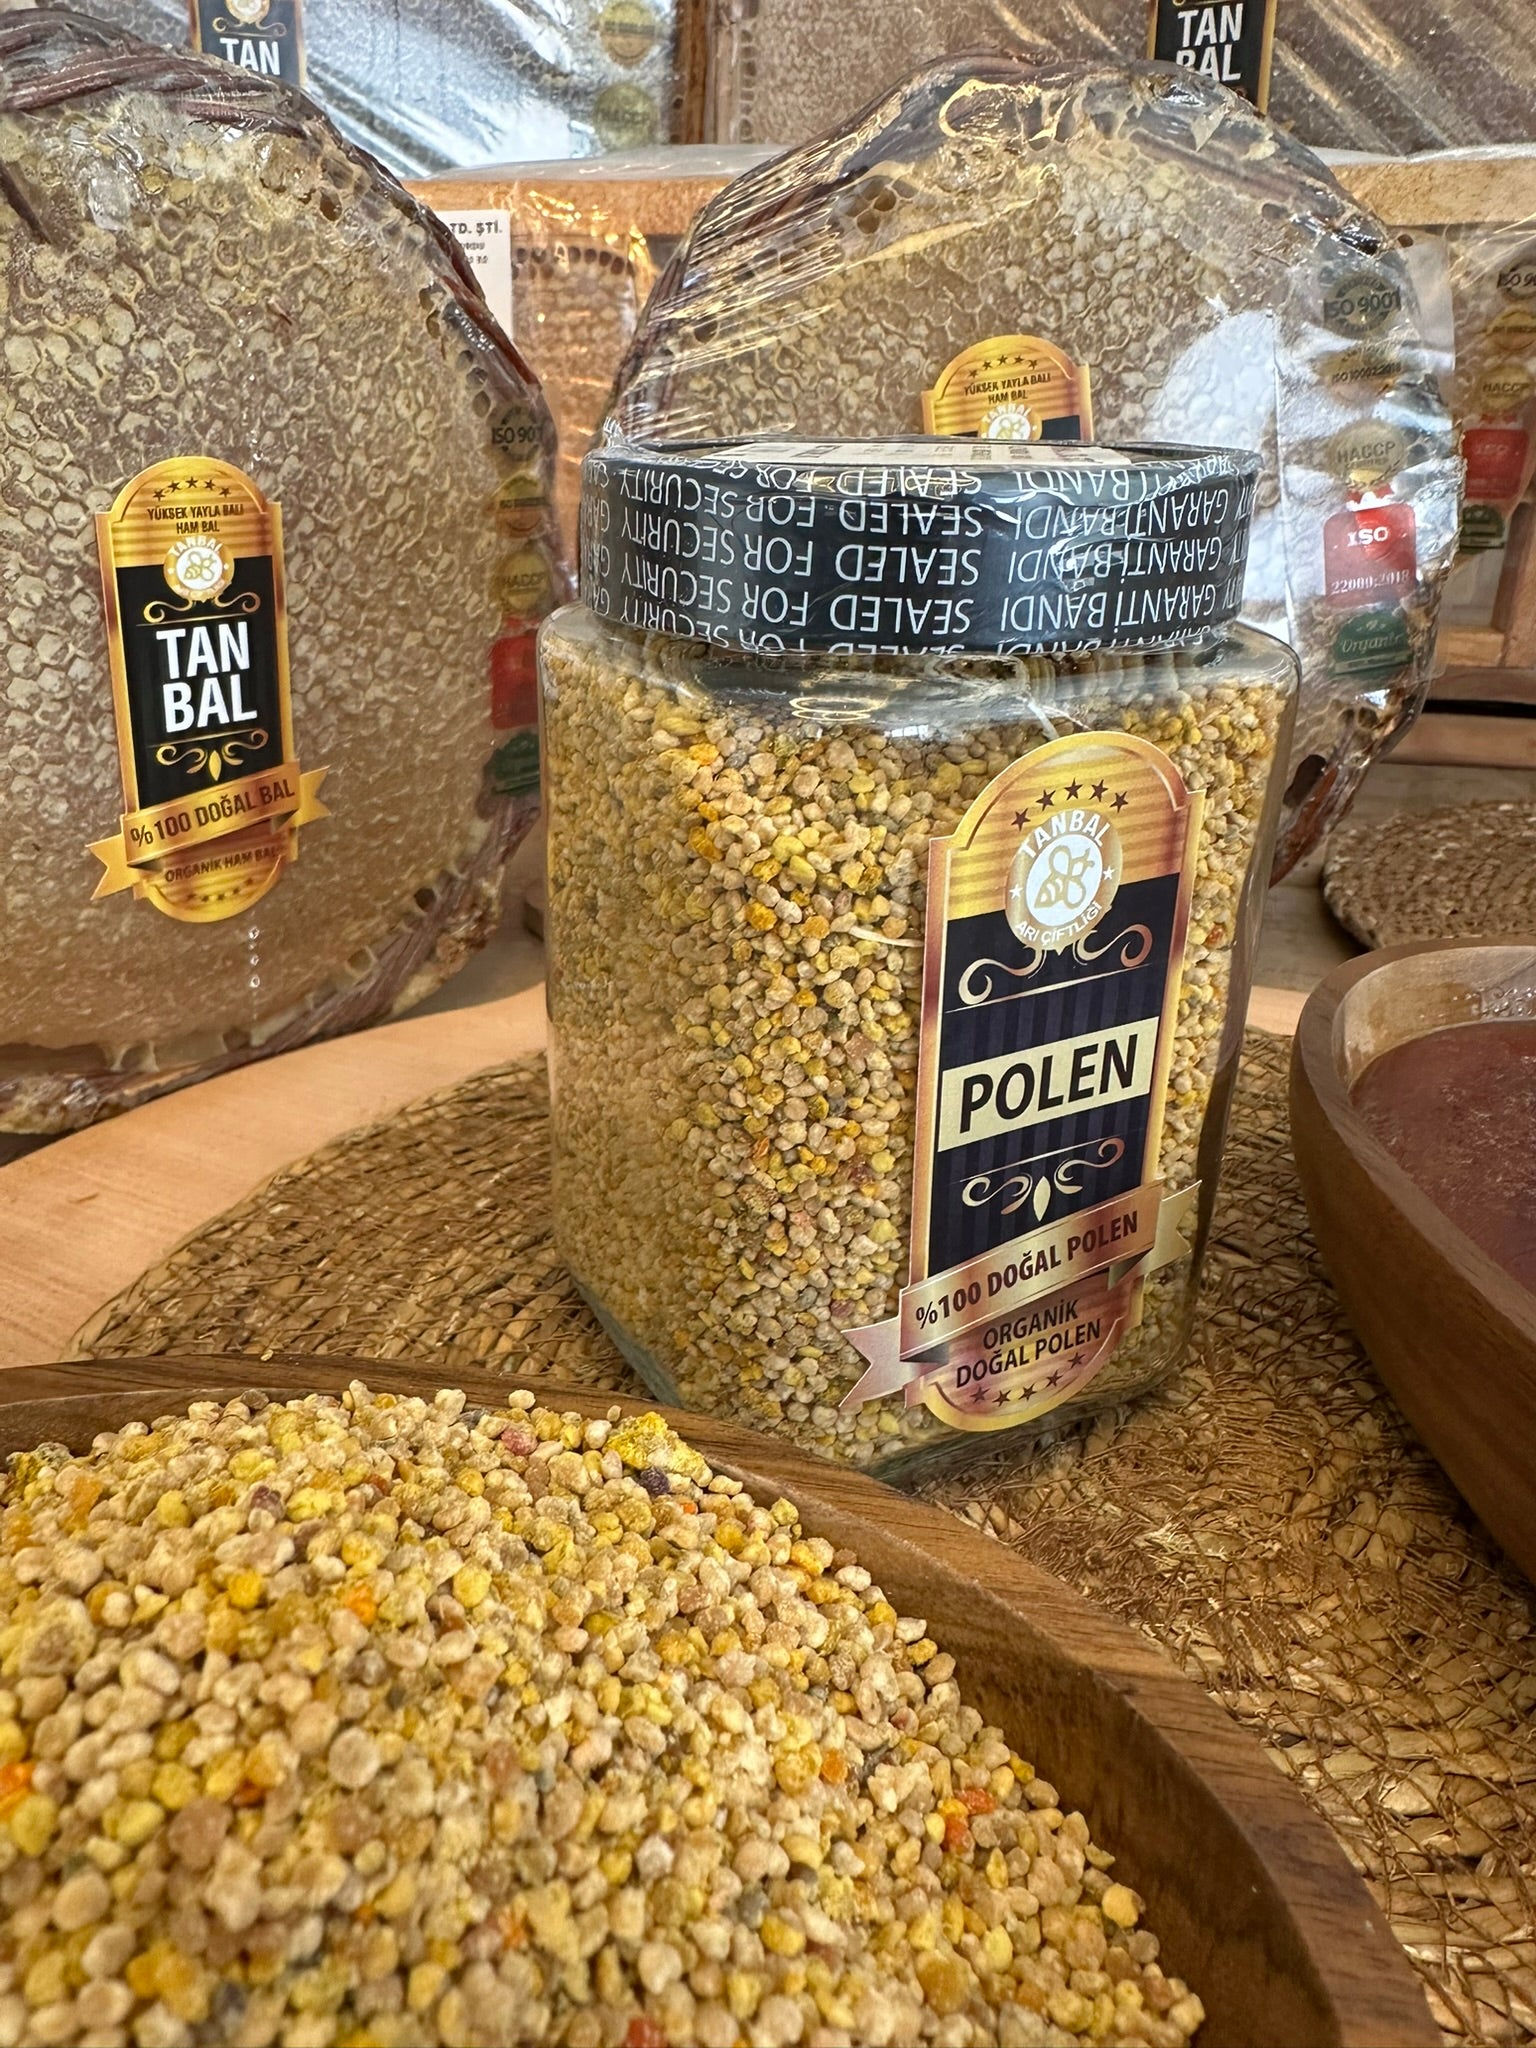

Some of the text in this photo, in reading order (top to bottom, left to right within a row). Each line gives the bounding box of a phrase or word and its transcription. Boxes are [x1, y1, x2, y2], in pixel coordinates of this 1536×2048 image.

[1177, 3, 1244, 48] TAN
[220, 37, 280, 76] TAN
[987, 392, 1010, 405] HAM
[1337, 440, 1396, 464] HACCP
[147, 505, 188, 521] YÜKSEK
[190, 504, 221, 519] YAYLA
[620, 468, 738, 519] SECURITY
[745, 495, 816, 528] FOR
[176, 520, 220, 535] HAM BAL
[621, 506, 735, 566] SECURITY
[838, 498, 984, 538] SEALED
[1347, 526, 1389, 547] ISO
[743, 534, 814, 577] FOR
[835, 543, 981, 587] SEALED
[621, 552, 733, 614] SECURITY
[741, 582, 809, 627] FOR
[829, 594, 974, 635] SEALED
[1001, 592, 1107, 632] BANDI
[1114, 583, 1216, 634] GARANTİ
[155, 621, 250, 680] TAN
[162, 673, 258, 733] BAL
[130, 778, 296, 848] %100 DOĞAL BAL
[1019, 808, 1111, 859] TANBAL
[224, 851, 252, 869] HAM
[1016, 900, 1103, 946] ARI ÇİFTLİĞİ
[959, 1033, 1139, 1135] POLEN
[915, 1210, 1138, 1330] %100 DOĞAL POLEN
[983, 1298, 1079, 1351] ORGANİK
[955, 1318, 1101, 1389] DOĞAL POLEN
